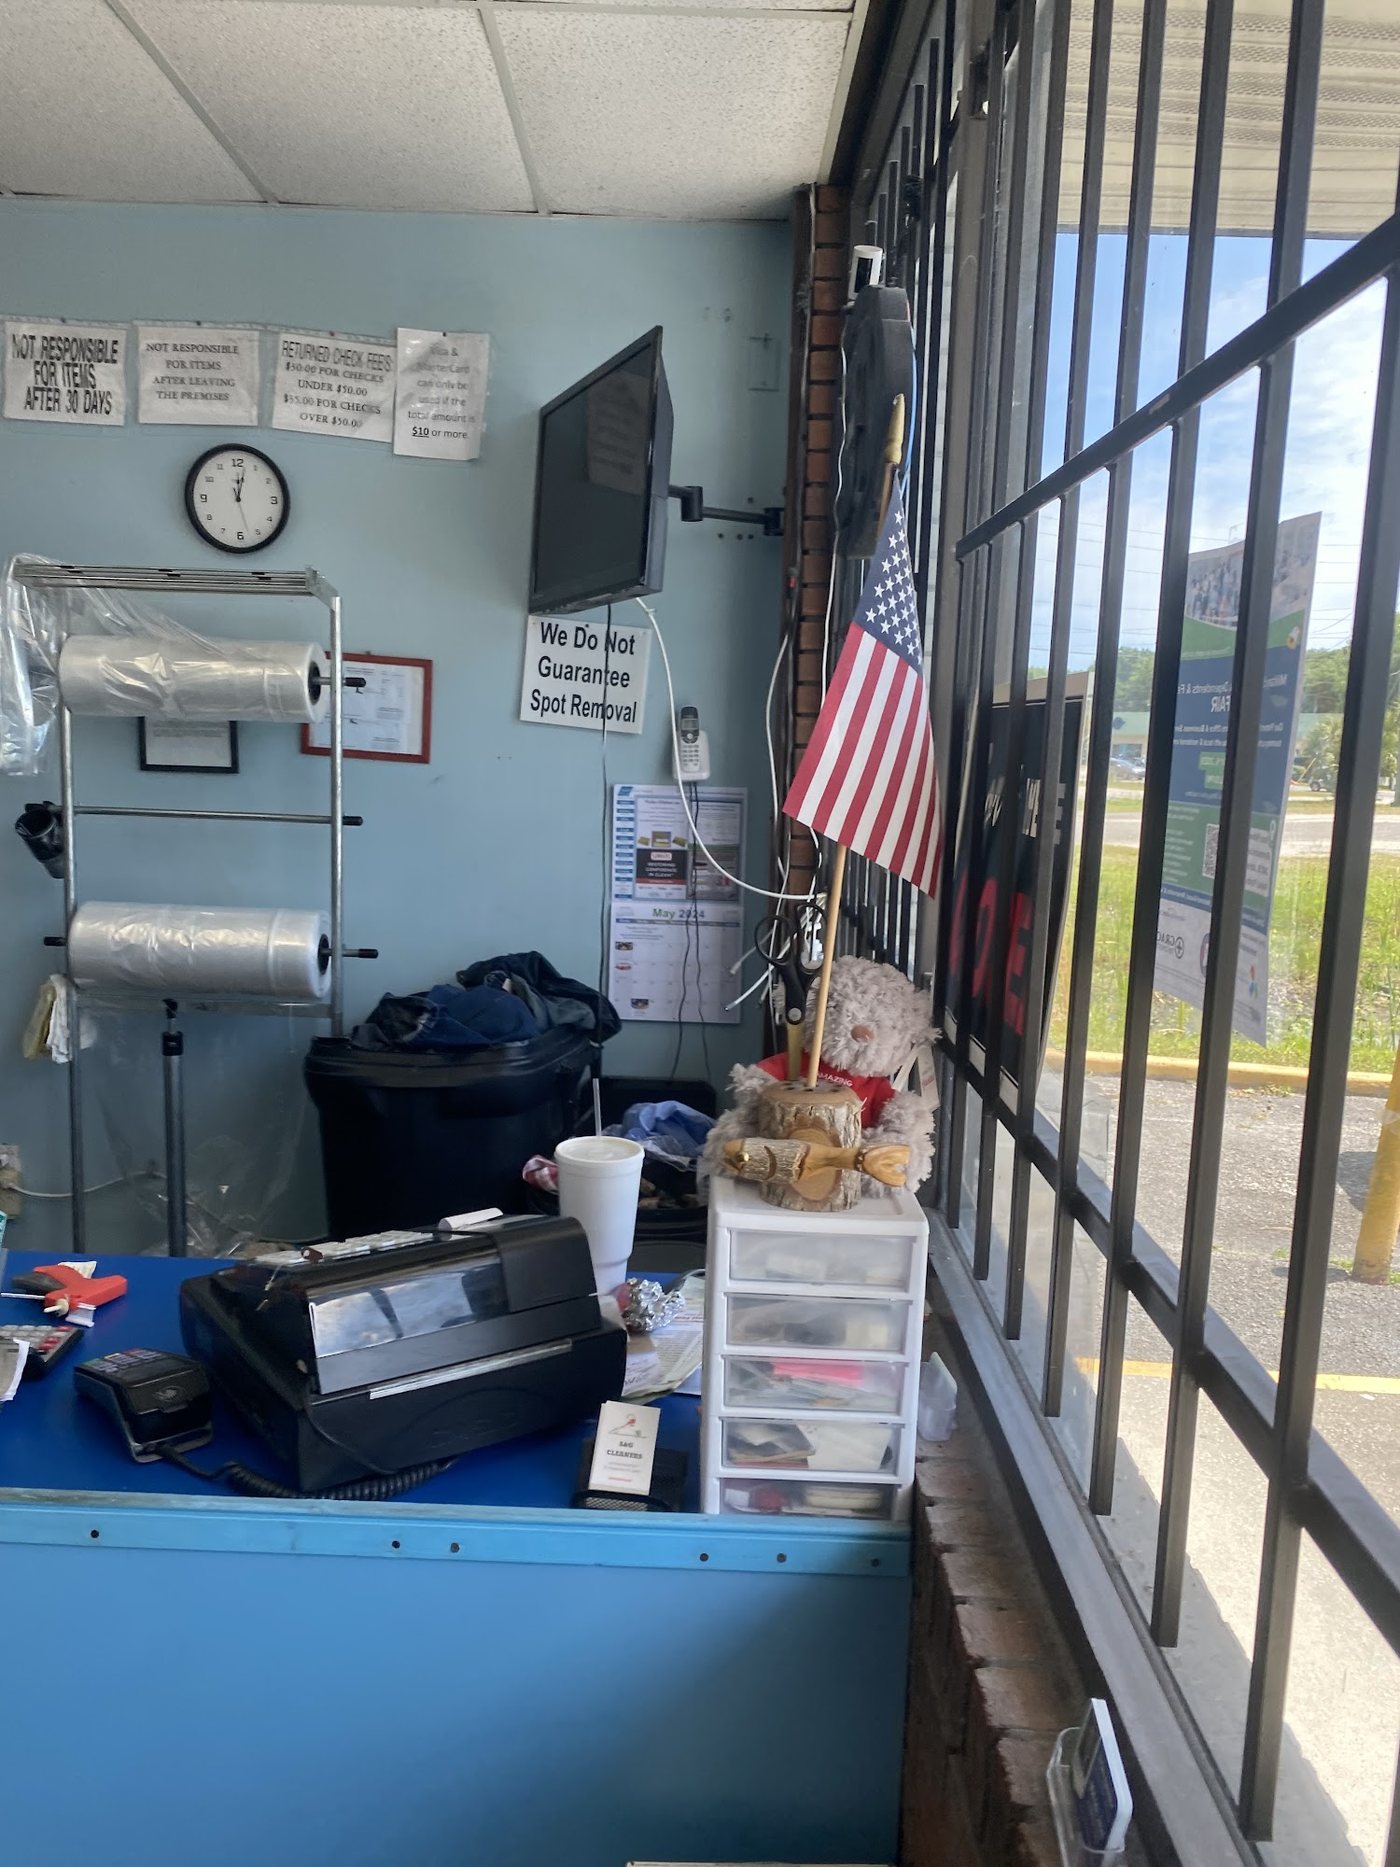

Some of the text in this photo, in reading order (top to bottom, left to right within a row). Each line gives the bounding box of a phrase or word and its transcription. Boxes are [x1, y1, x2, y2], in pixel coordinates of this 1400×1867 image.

[12, 334, 118, 364] NOT RESPONSIBLE
[146, 343, 239, 355] NOT RESPONSIBLE
[282, 340, 330, 363] RETURNED
[333, 347, 364, 369] CHECK
[166, 360, 222, 371] FOR ITEMS
[34, 360, 96, 389] FOR ITEMS
[319, 366, 340, 378] FOR
[343, 370, 384, 383] CHECKS
[153, 376, 235, 388] AFTER LEAVING
[298, 379, 333, 393] UNDER
[24, 386, 112, 415] AFTER 30 DAYS
[156, 391, 230, 401] THE PREMISES
[316, 398, 337, 409] FOR
[341, 401, 381, 415] CHECKS
[300, 412, 329, 424] OVER
[430, 412, 466, 423] amount
[412, 426, 430, 437] $10
[431, 429, 442, 437] or
[231, 458, 244, 467] 12
[200, 494, 208, 503] 9
[270, 496, 278, 505] 3
[237, 532, 244, 540] 6
[540, 621, 636, 655] We Do Not
[538, 655, 630, 688] Guarantee
[530, 688, 637, 723] Spot Removal
[652, 908, 705, 919] May 2024
